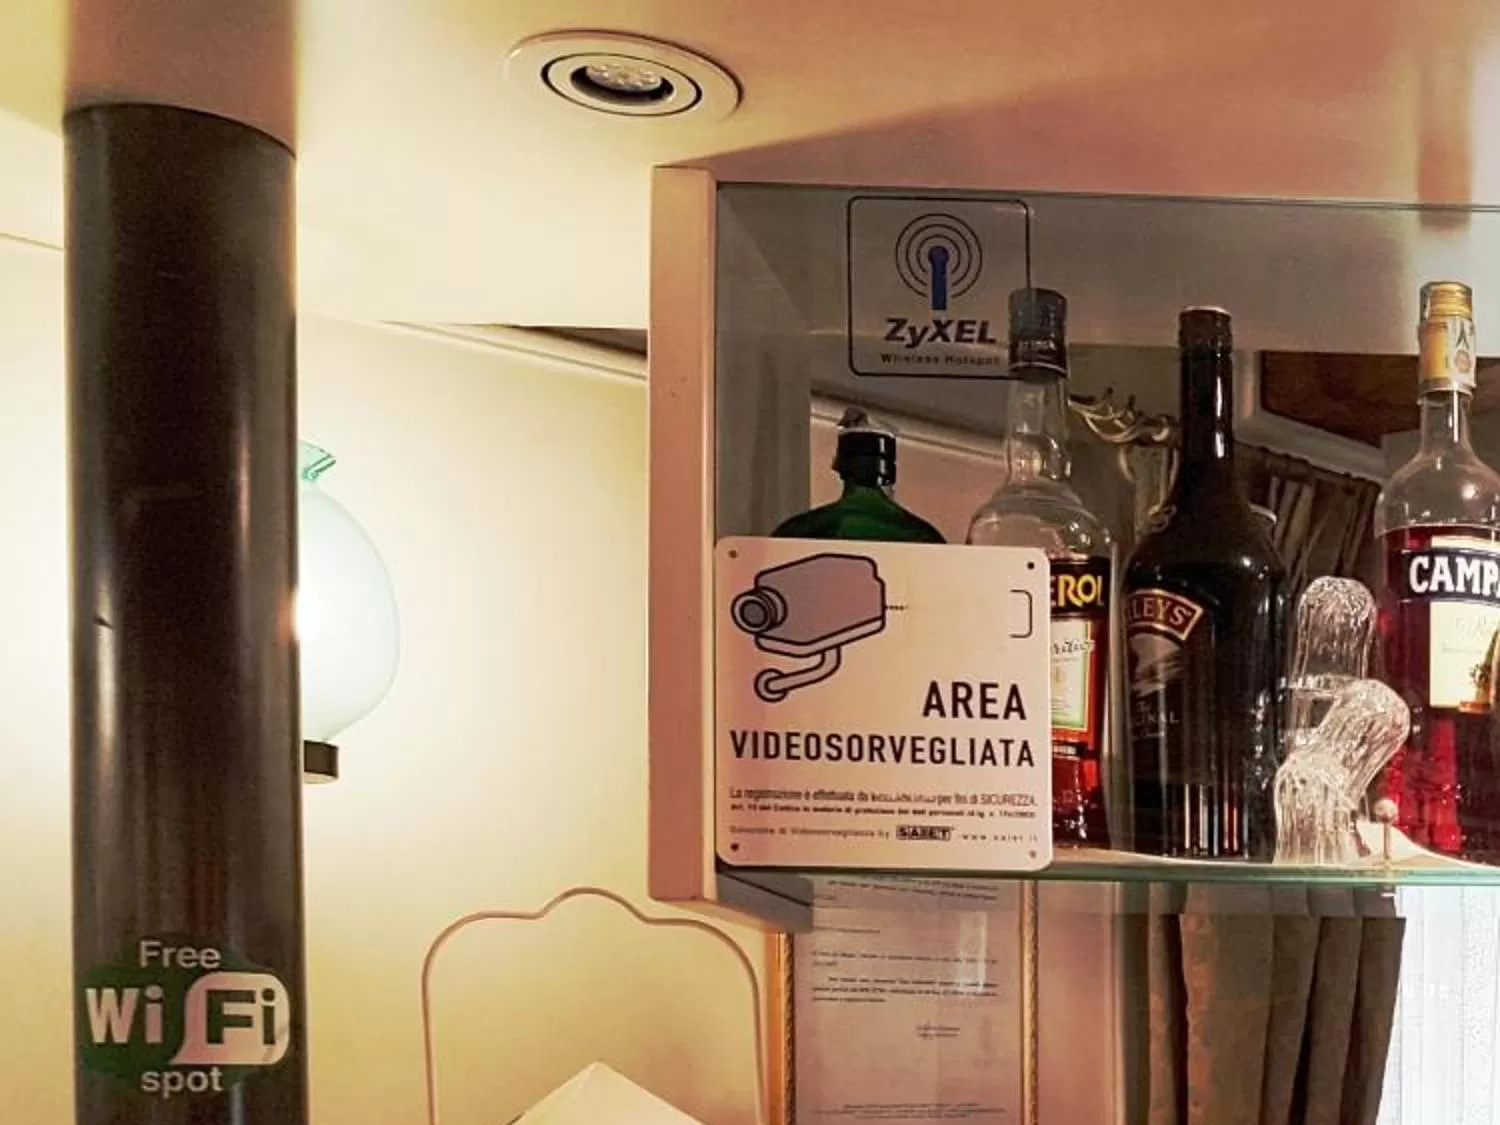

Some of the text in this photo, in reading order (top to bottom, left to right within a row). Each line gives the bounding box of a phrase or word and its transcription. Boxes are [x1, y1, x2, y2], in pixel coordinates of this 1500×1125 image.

[884, 317, 997, 348] ZyXEL
[922, 680, 1027, 721] AREA
[730, 730, 1035, 768] VIDEOSORVEGLIATA
[139, 941, 222, 970] Free
[141, 1067, 224, 1099] spot
